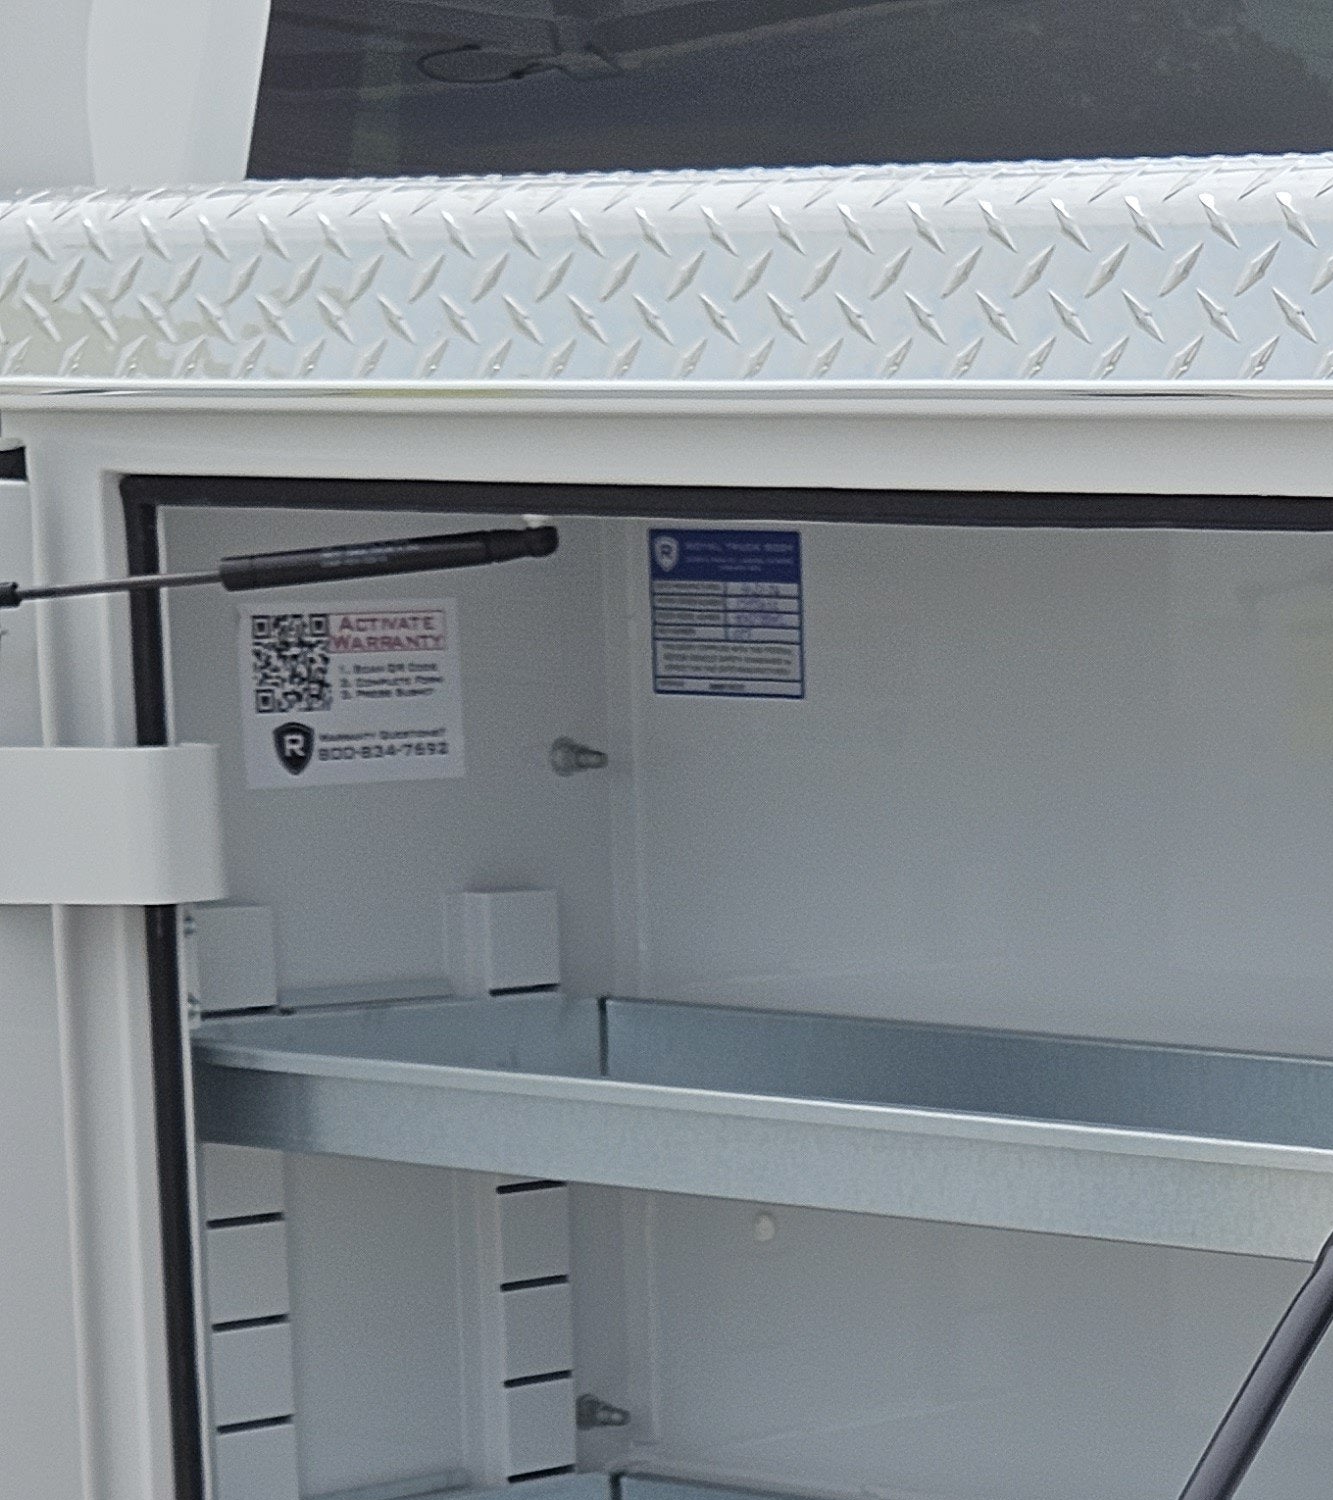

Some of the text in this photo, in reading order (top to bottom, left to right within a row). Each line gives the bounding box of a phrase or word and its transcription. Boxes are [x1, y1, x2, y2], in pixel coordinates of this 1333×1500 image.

[340, 616, 435, 632] ACTIVATE
[332, 634, 443, 649] WARRANTY
[284, 734, 305, 757] R
[319, 742, 448, 761] 800-834-7692
